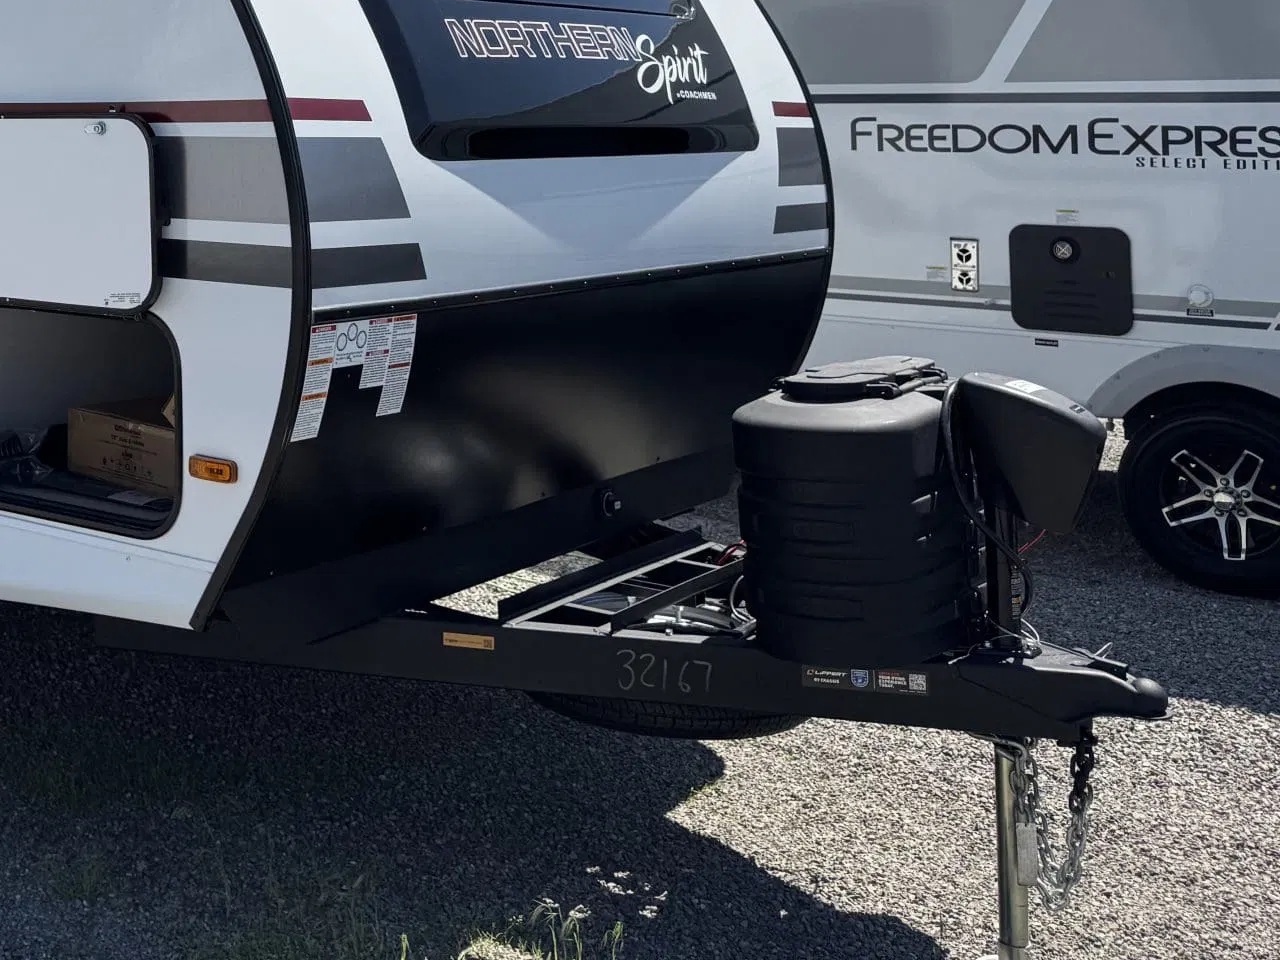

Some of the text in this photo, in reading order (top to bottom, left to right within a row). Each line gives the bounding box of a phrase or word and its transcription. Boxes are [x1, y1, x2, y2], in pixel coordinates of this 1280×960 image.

[444, 19, 709, 104] NORTHERN Spirit
[679, 90, 717, 101] COACHMEN
[850, 117, 1280, 158] FREEDOM EXPRES
[1136, 157, 1208, 169] SELECT
[617, 649, 712, 693] 32167
